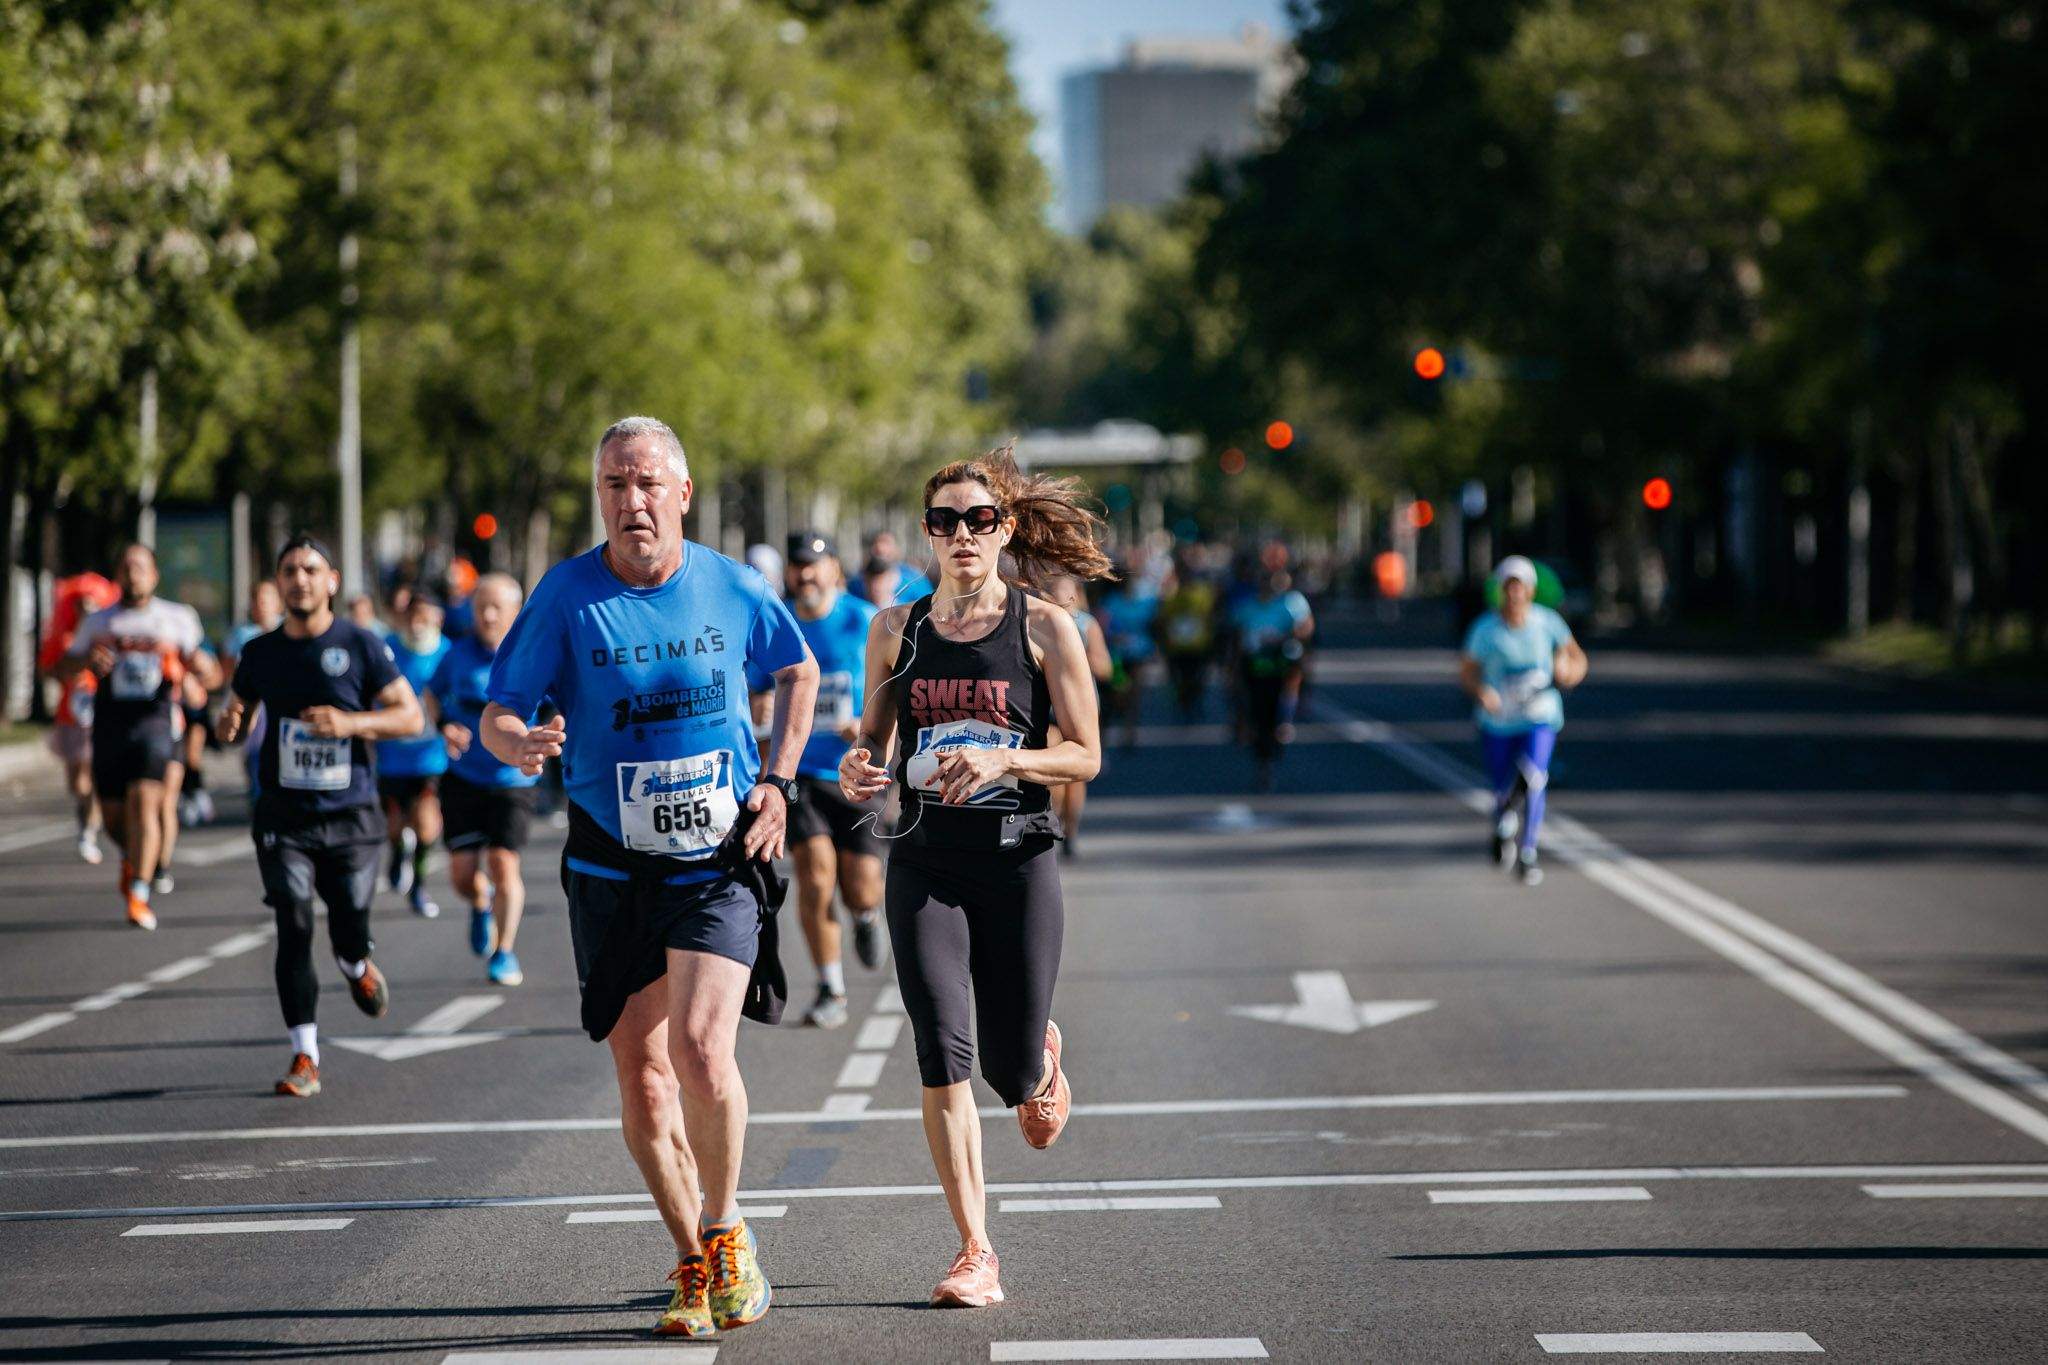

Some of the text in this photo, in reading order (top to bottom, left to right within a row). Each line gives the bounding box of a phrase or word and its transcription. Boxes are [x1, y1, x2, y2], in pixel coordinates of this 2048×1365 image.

[592, 634, 725, 667] DECIMAS
[641, 684, 724, 708] BOMBEROS
[691, 696, 724, 716] MADRID
[910, 678, 1010, 712] SWEAT
[660, 769, 713, 785] BOMBEROS
[655, 785, 712, 802] DECIMAS
[653, 798, 711, 834] 655
